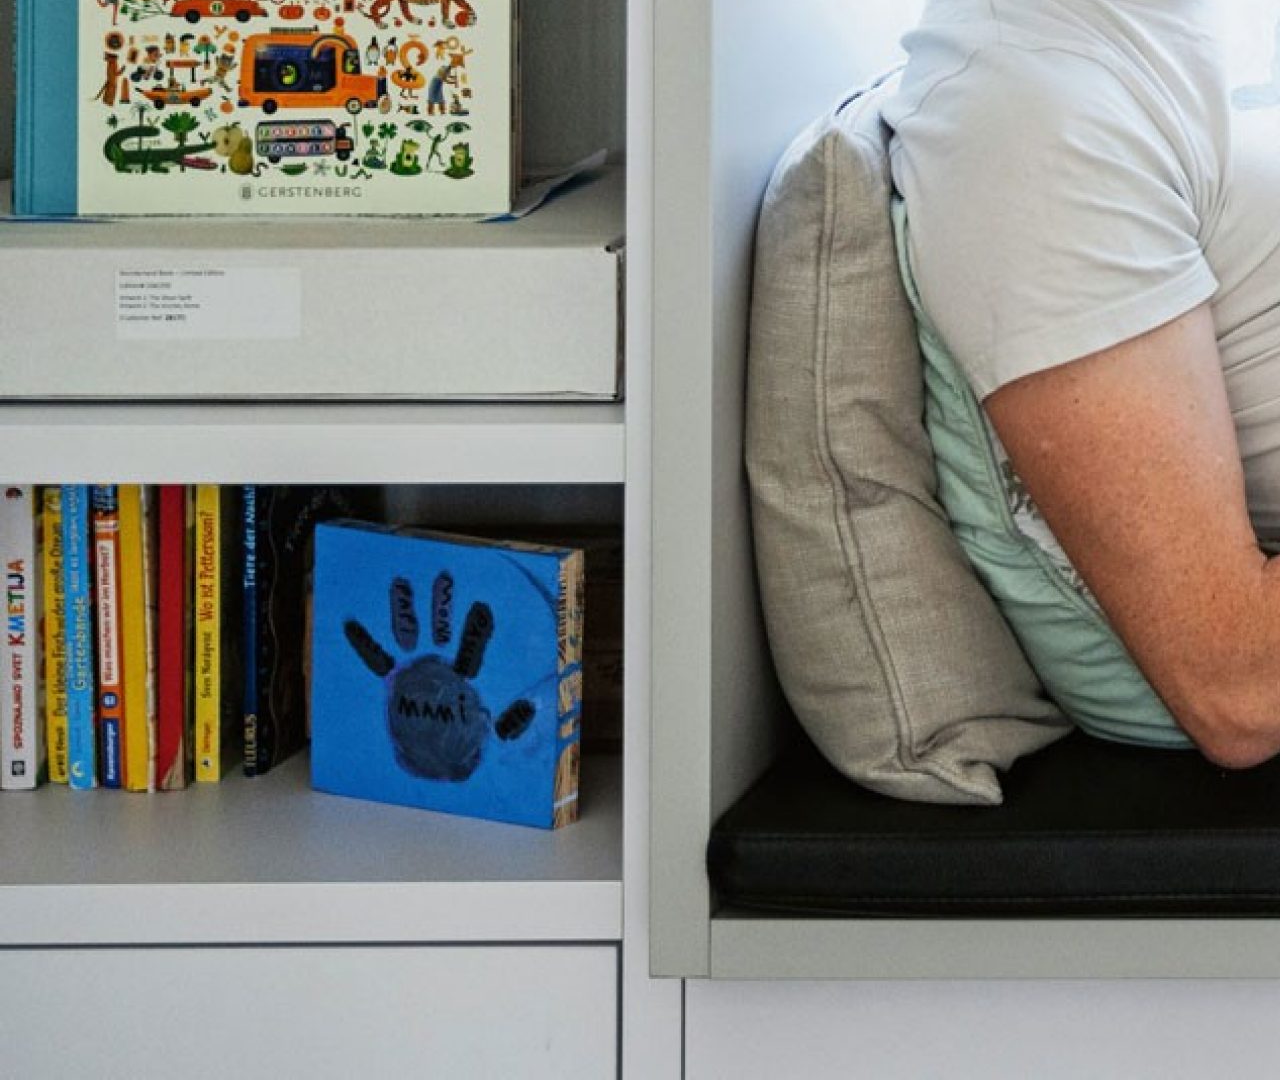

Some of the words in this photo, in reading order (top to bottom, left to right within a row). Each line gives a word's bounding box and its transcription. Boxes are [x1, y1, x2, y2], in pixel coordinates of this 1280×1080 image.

[257, 186, 363, 199] GERSTENBERG
[199, 511, 215, 579] Pettersson?
[244, 528, 256, 549] der
[244, 554, 256, 588] Tiere
[8, 560, 24, 646] KMETIJA
[200, 601, 213, 621] Wo
[71, 596, 87, 690] Gartenbande
[12, 654, 22, 680] SVET
[103, 662, 113, 681] Was
